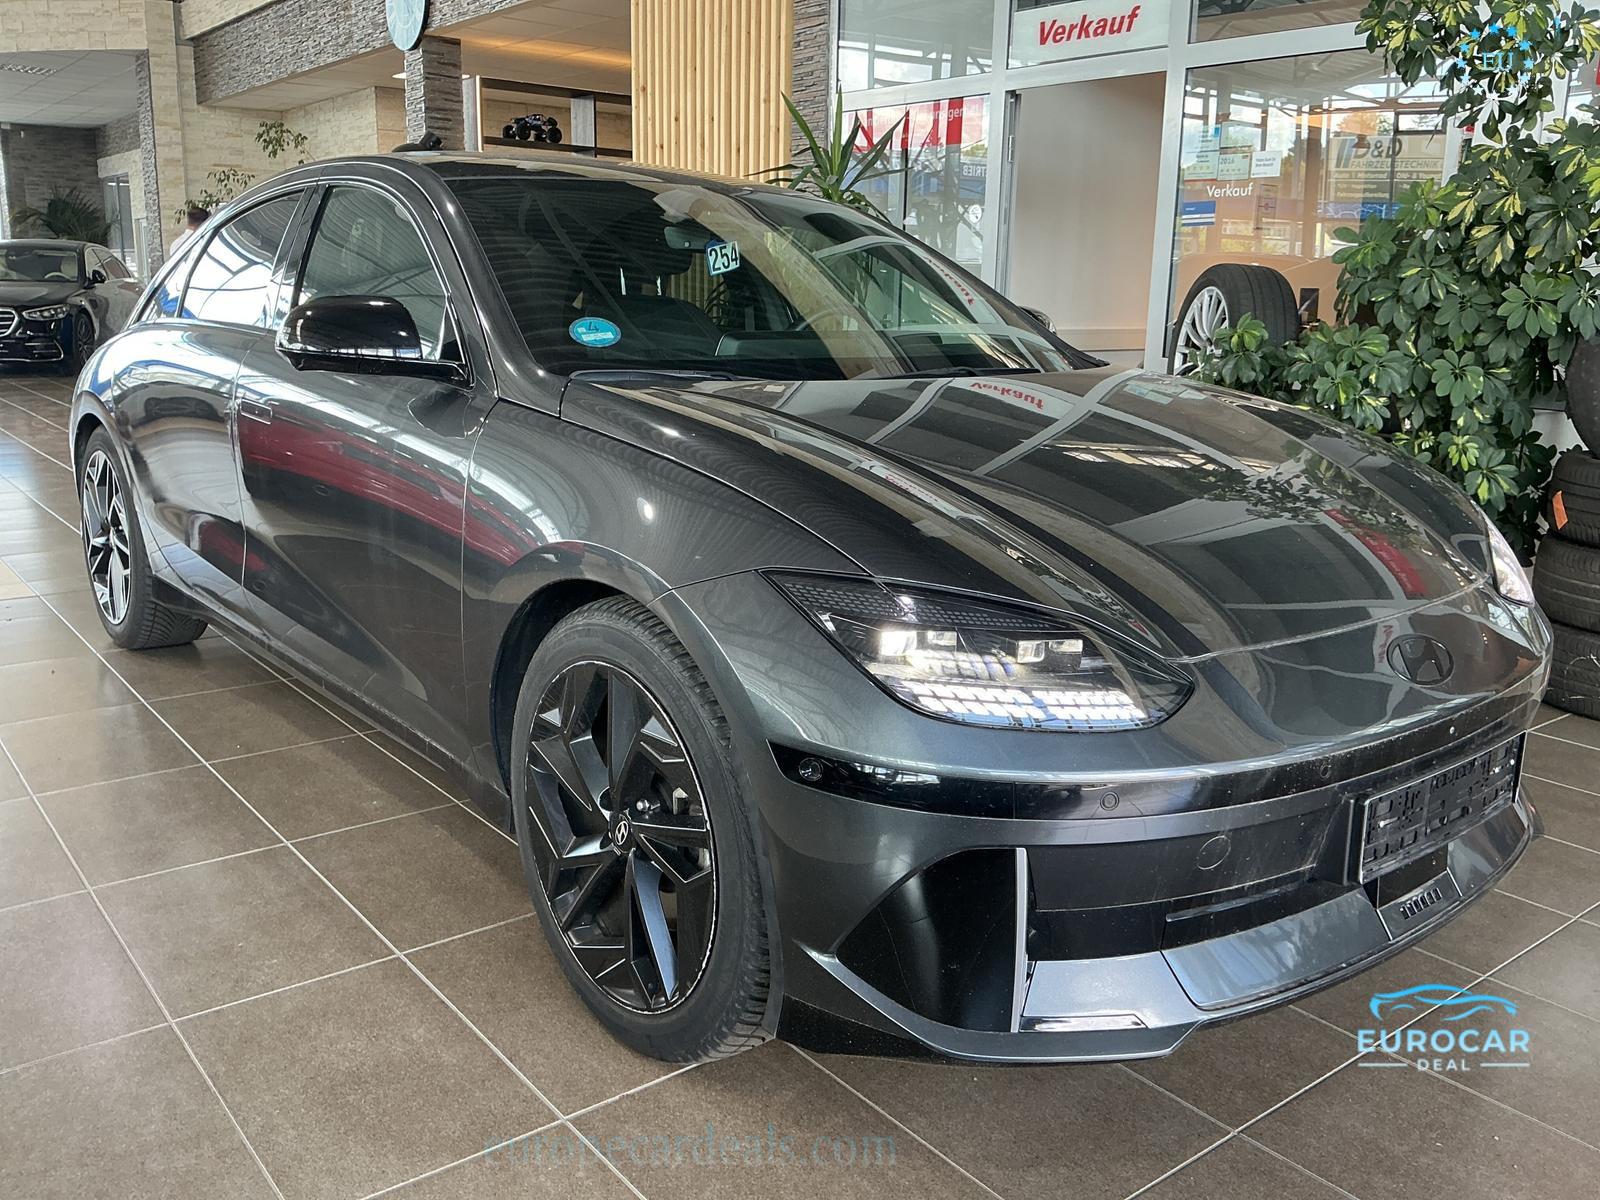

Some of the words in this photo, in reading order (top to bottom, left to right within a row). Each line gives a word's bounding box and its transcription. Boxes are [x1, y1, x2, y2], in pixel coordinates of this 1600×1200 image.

[1039, 5, 1142, 46] Verkauf
[1352, 138, 1403, 159] D&D
[1206, 182, 1254, 198] Verkauf
[709, 245, 739, 272] 254
